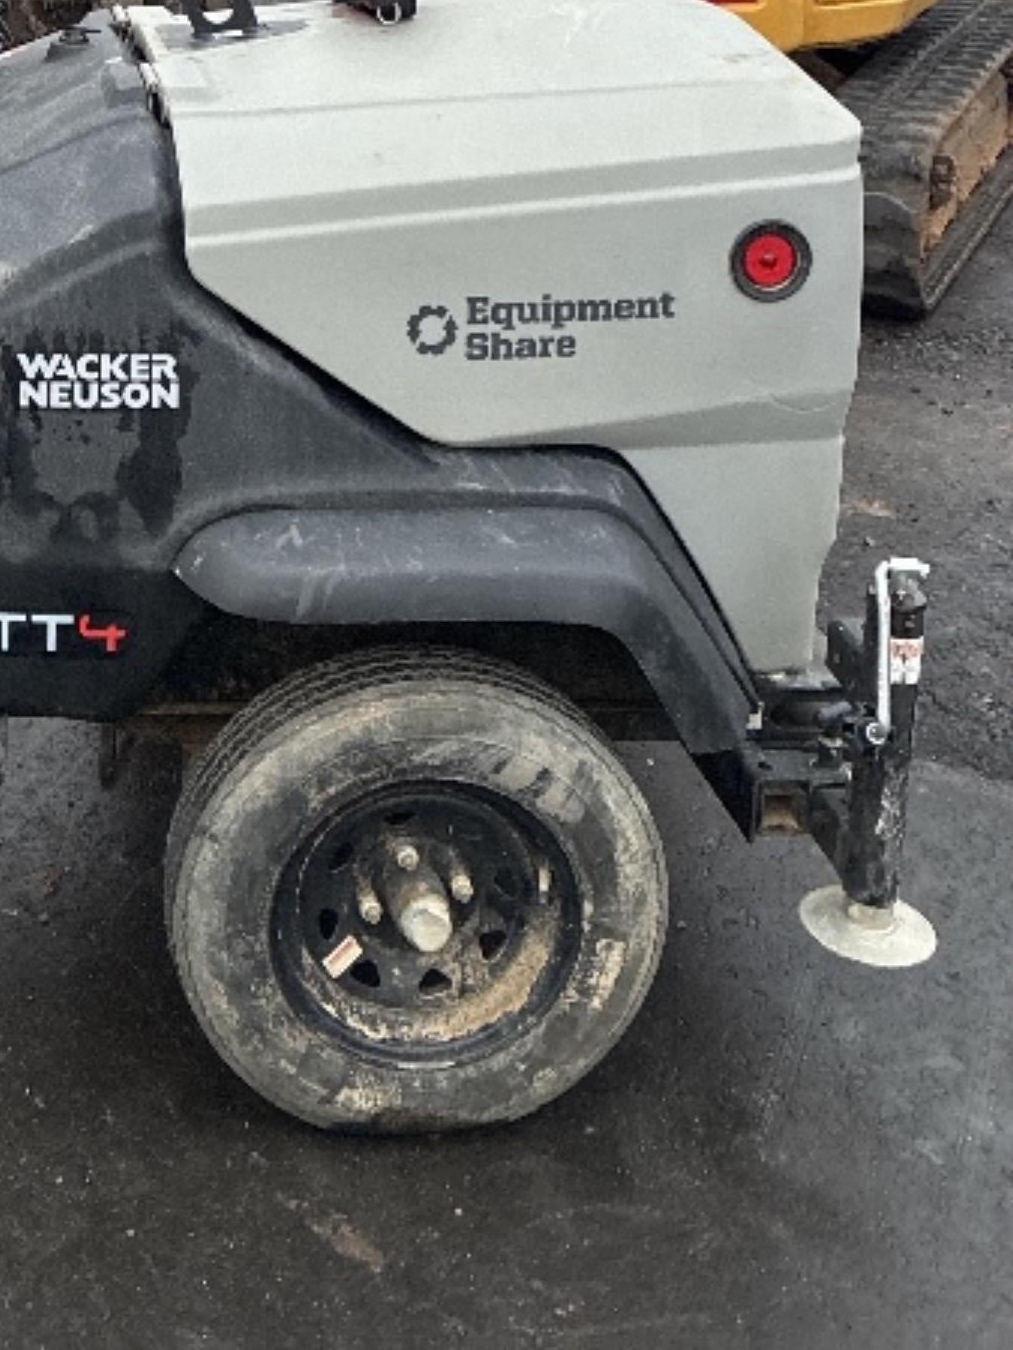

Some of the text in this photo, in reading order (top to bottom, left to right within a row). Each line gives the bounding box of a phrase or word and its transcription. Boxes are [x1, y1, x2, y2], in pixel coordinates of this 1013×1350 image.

[465, 292, 676, 331] Equipment
[465, 332, 577, 361] Share
[16, 352, 180, 383] WACKER
[19, 380, 181, 410] NEUSON
